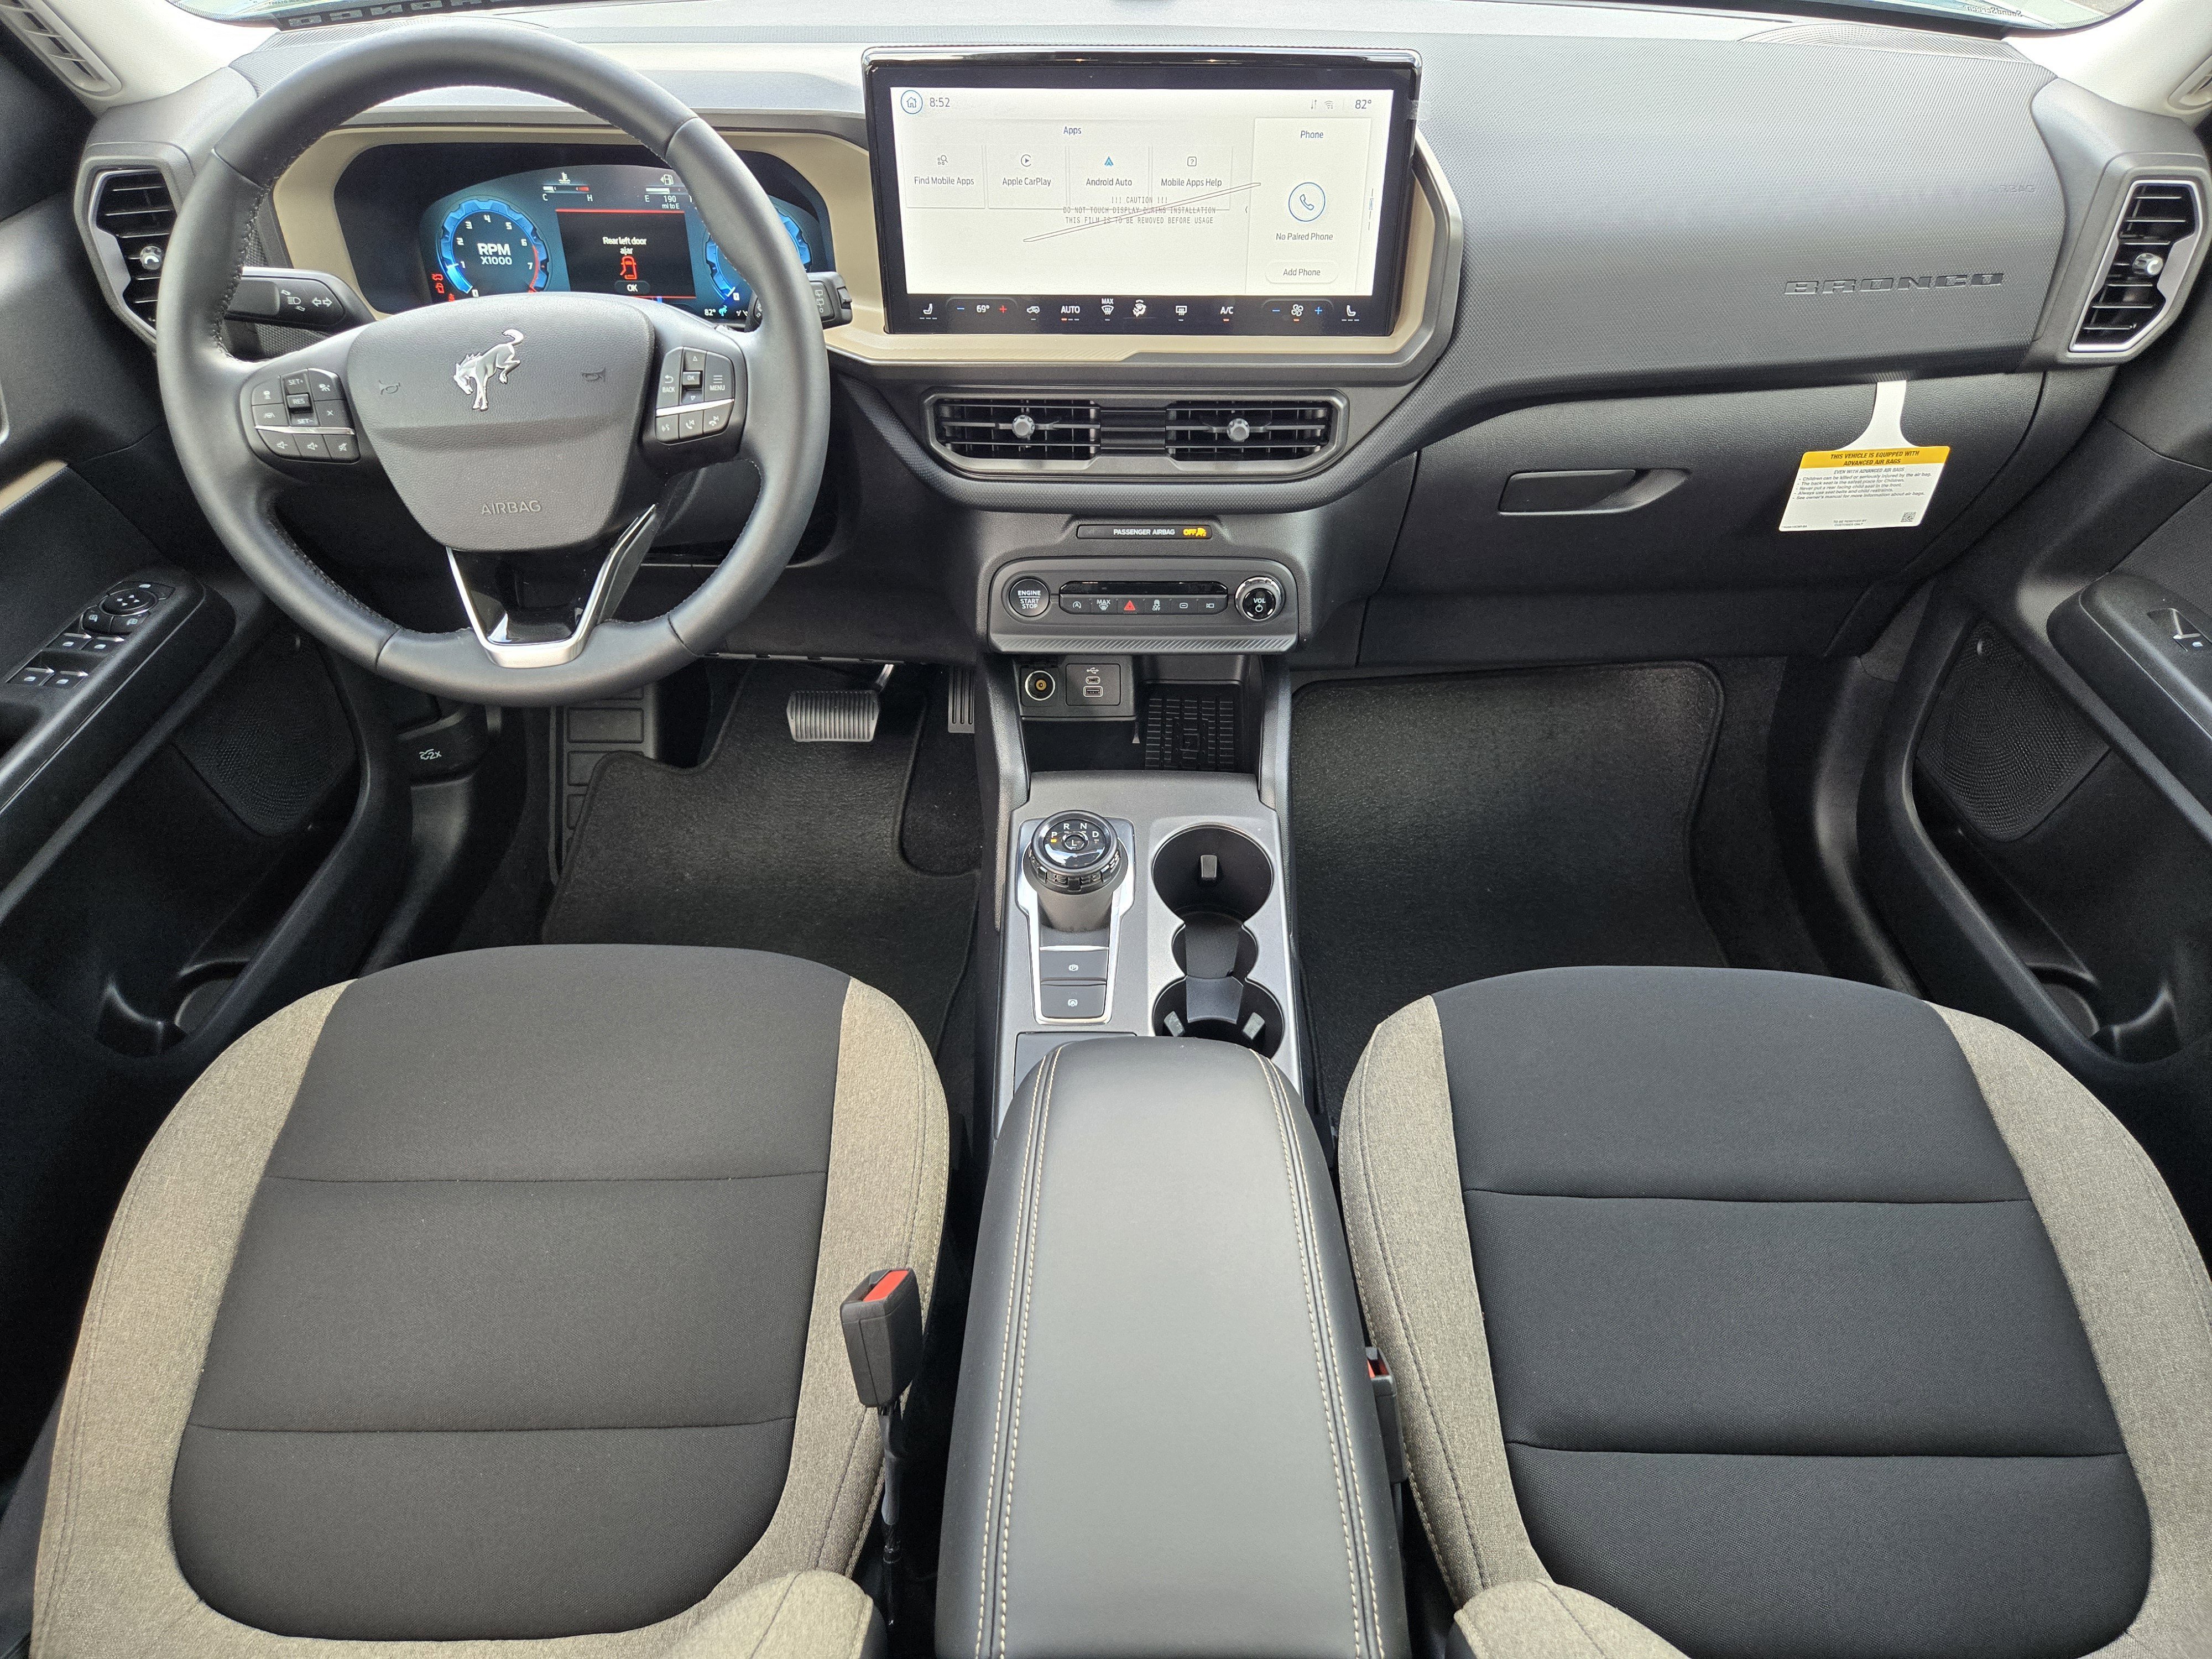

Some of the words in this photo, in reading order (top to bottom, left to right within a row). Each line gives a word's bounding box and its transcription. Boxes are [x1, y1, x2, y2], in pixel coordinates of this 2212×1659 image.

[929, 97, 950, 108] 8:52
[1355, 99, 1371, 109] 82°
[1063, 126, 1082, 136] Apps
[1300, 131, 1324, 139] Phone
[914, 176, 930, 185] Find
[931, 176, 955, 185] Mobile
[957, 177, 974, 186] Apps
[1002, 178, 1021, 187] Apple
[1022, 178, 1051, 187] CarPlay
[1086, 177, 1114, 186] Android
[1115, 178, 1133, 186] Auto
[1161, 178, 1185, 187] Mobile
[1186, 179, 1203, 188] Apps
[1205, 179, 1222, 188] Help
[465, 221, 473, 229] 3
[457, 237, 464, 246] 2
[521, 238, 527, 247] 6
[603, 237, 619, 245] Rear
[619, 237, 630, 245] left
[631, 237, 647, 245] door
[477, 243, 511, 255] RPM
[620, 247, 633, 255] ajar
[481, 256, 512, 265] X1000
[627, 284, 638, 292] OK
[1784, 273, 2004, 295] BRONCO
[472, 289, 479, 298] 0
[733, 293, 740, 301] 0
[1061, 306, 1081, 314] AUTO
[482, 500, 541, 515] AIRBAG
